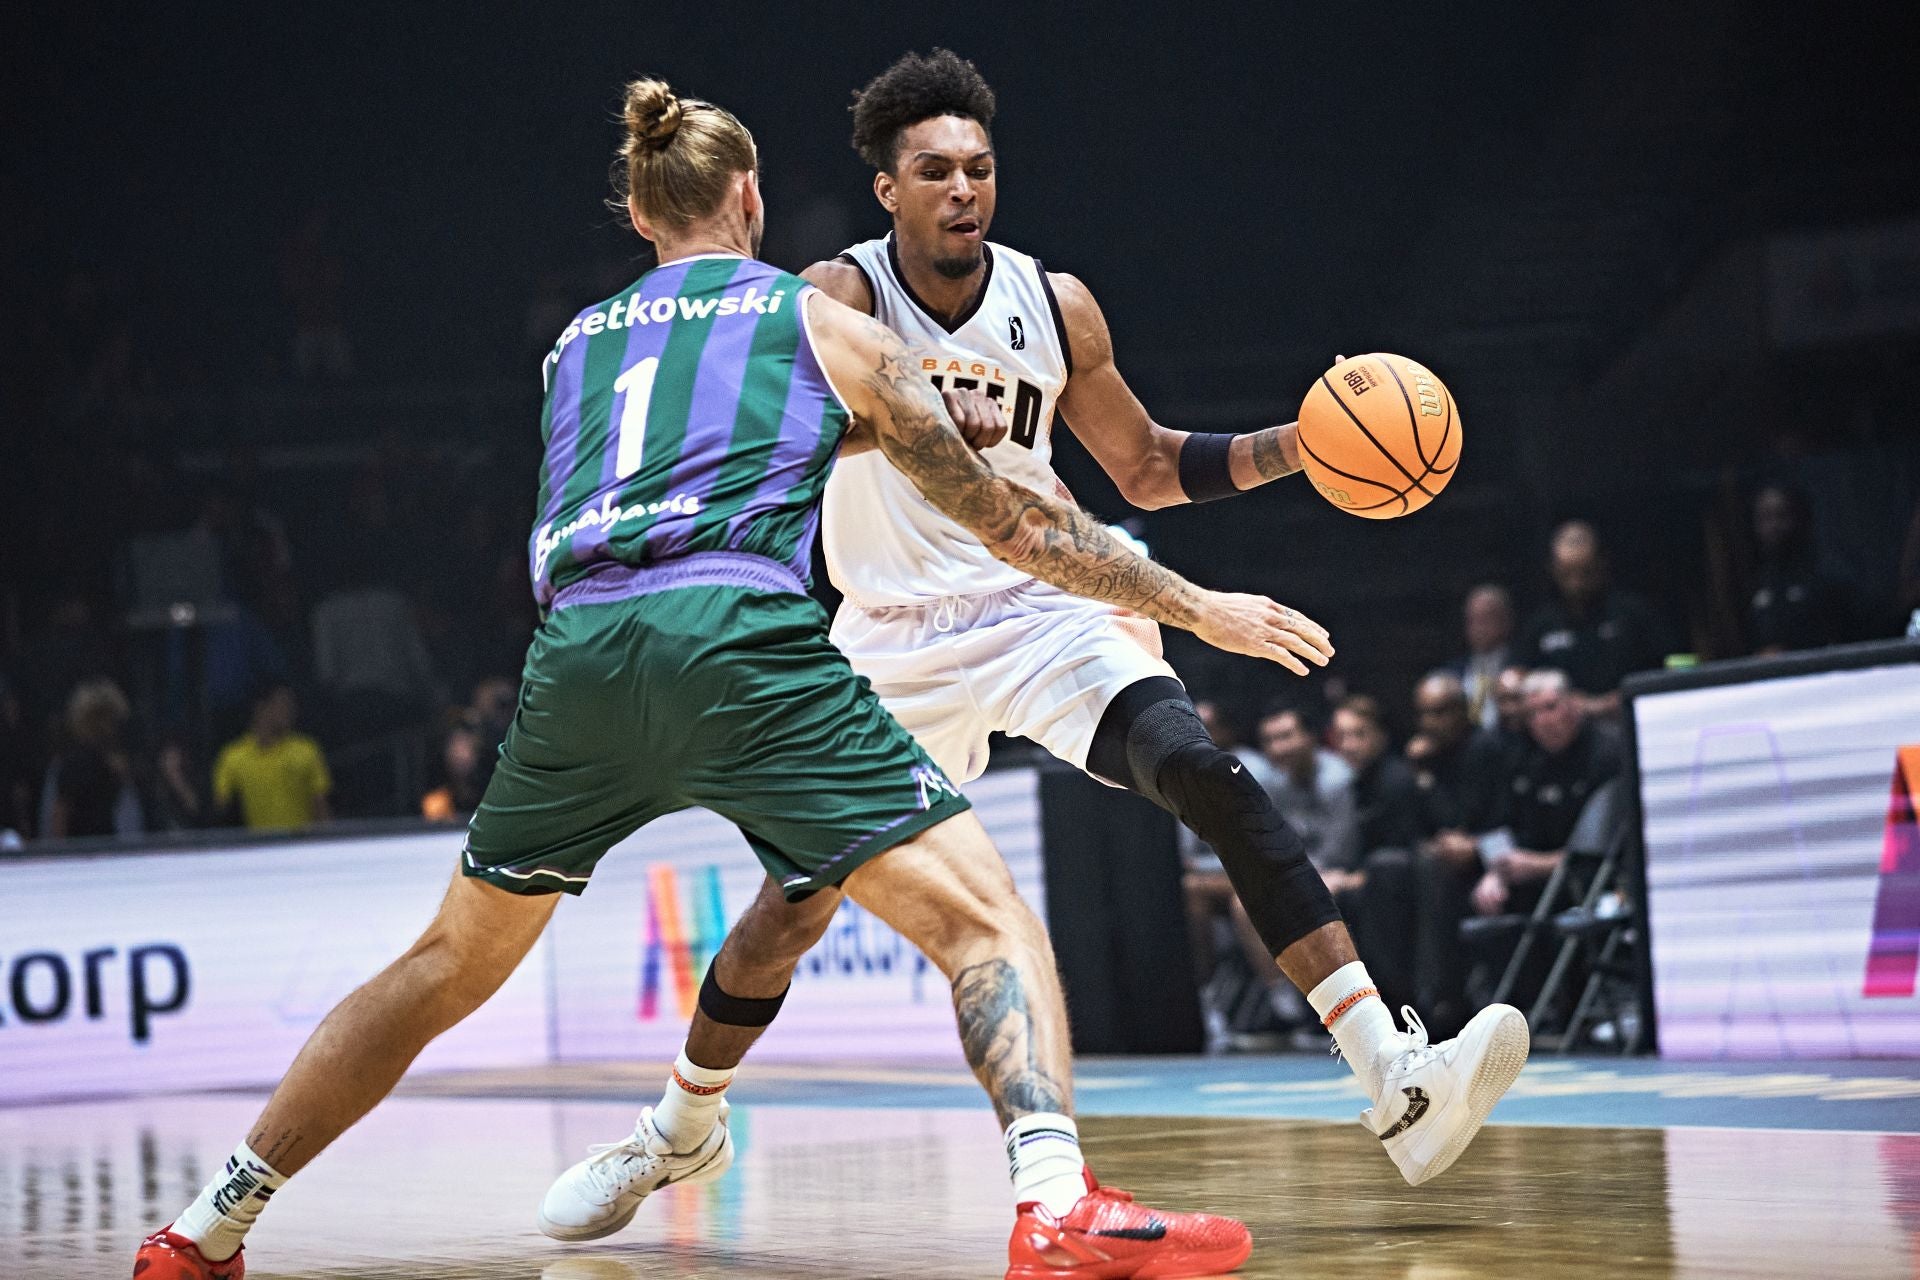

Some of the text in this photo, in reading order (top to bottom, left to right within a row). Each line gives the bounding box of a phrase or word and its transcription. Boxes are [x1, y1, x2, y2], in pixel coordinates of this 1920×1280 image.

[921, 358, 1006, 382] BAGL
[1343, 369, 1370, 397] FIBA
[613, 356, 660, 480] 1
[0, 944, 191, 1043] orp
